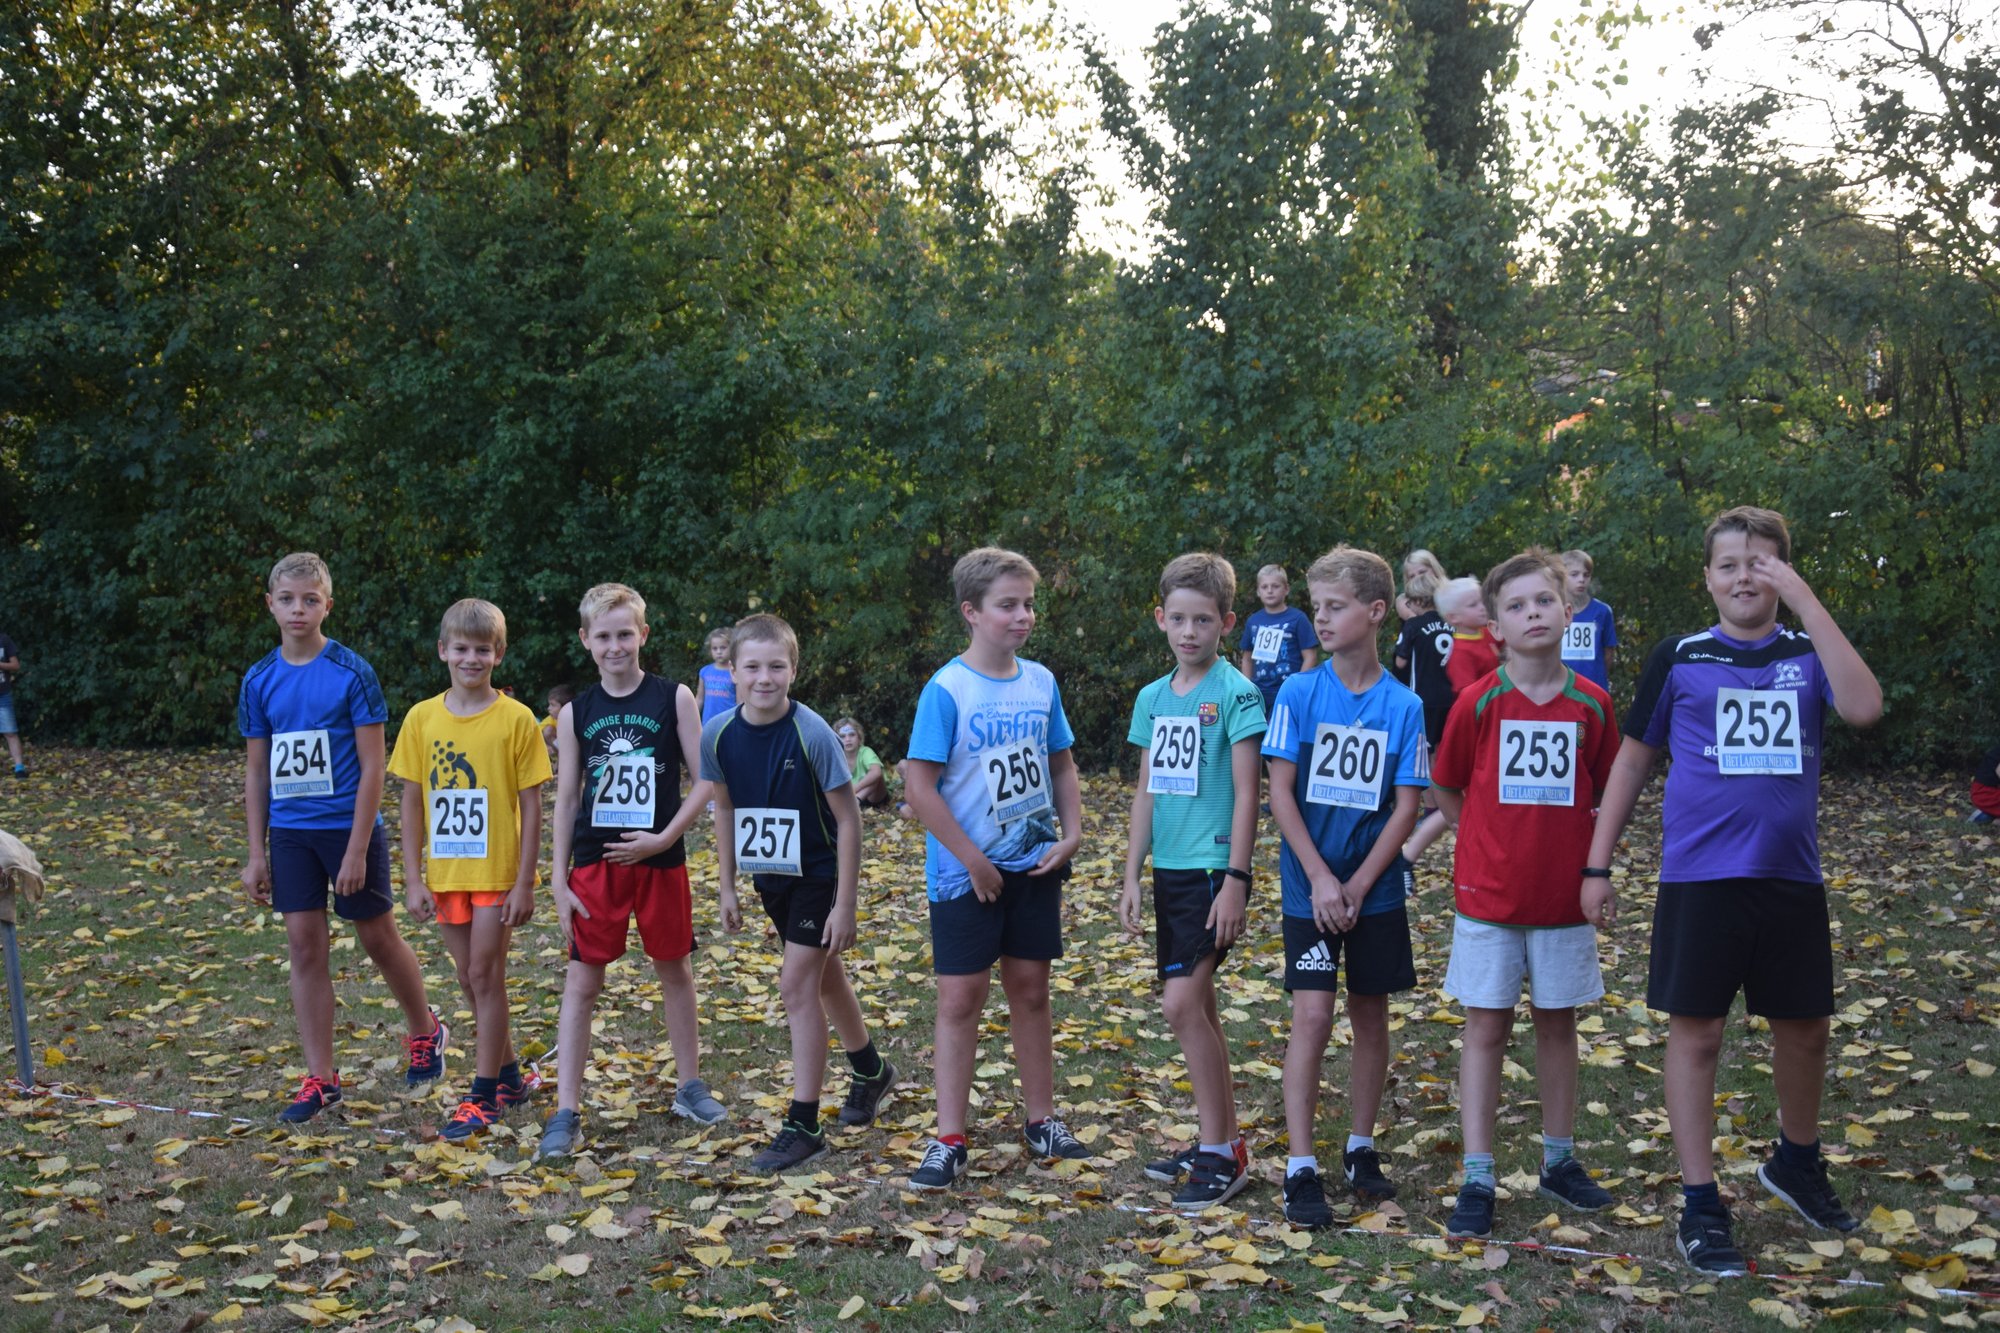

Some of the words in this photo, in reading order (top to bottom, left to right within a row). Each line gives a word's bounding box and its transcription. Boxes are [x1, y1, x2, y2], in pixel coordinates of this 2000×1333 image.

[1258, 630, 1280, 651] 191
[1435, 633, 1454, 667] 9
[1565, 627, 1591, 648] 198
[584, 715, 621, 740] SUNRISE
[624, 714, 661, 734] BOARDS
[1723, 699, 1794, 748] 252
[275, 737, 327, 777] 254
[1153, 725, 1196, 770] 259
[1316, 732, 1380, 784] 260
[1505, 730, 1570, 779] 253
[1725, 754, 1739, 767] HET
[1740, 754, 1767, 768] LAATSTE
[1768, 754, 1794, 768] NIEUWS
[598, 765, 651, 805] 258
[989, 746, 1041, 802] 256
[1314, 785, 1327, 797] HET
[1506, 786, 1518, 798] HET
[1518, 786, 1544, 800] LAATSTE
[435, 797, 484, 836] 255
[741, 816, 795, 858] 257
